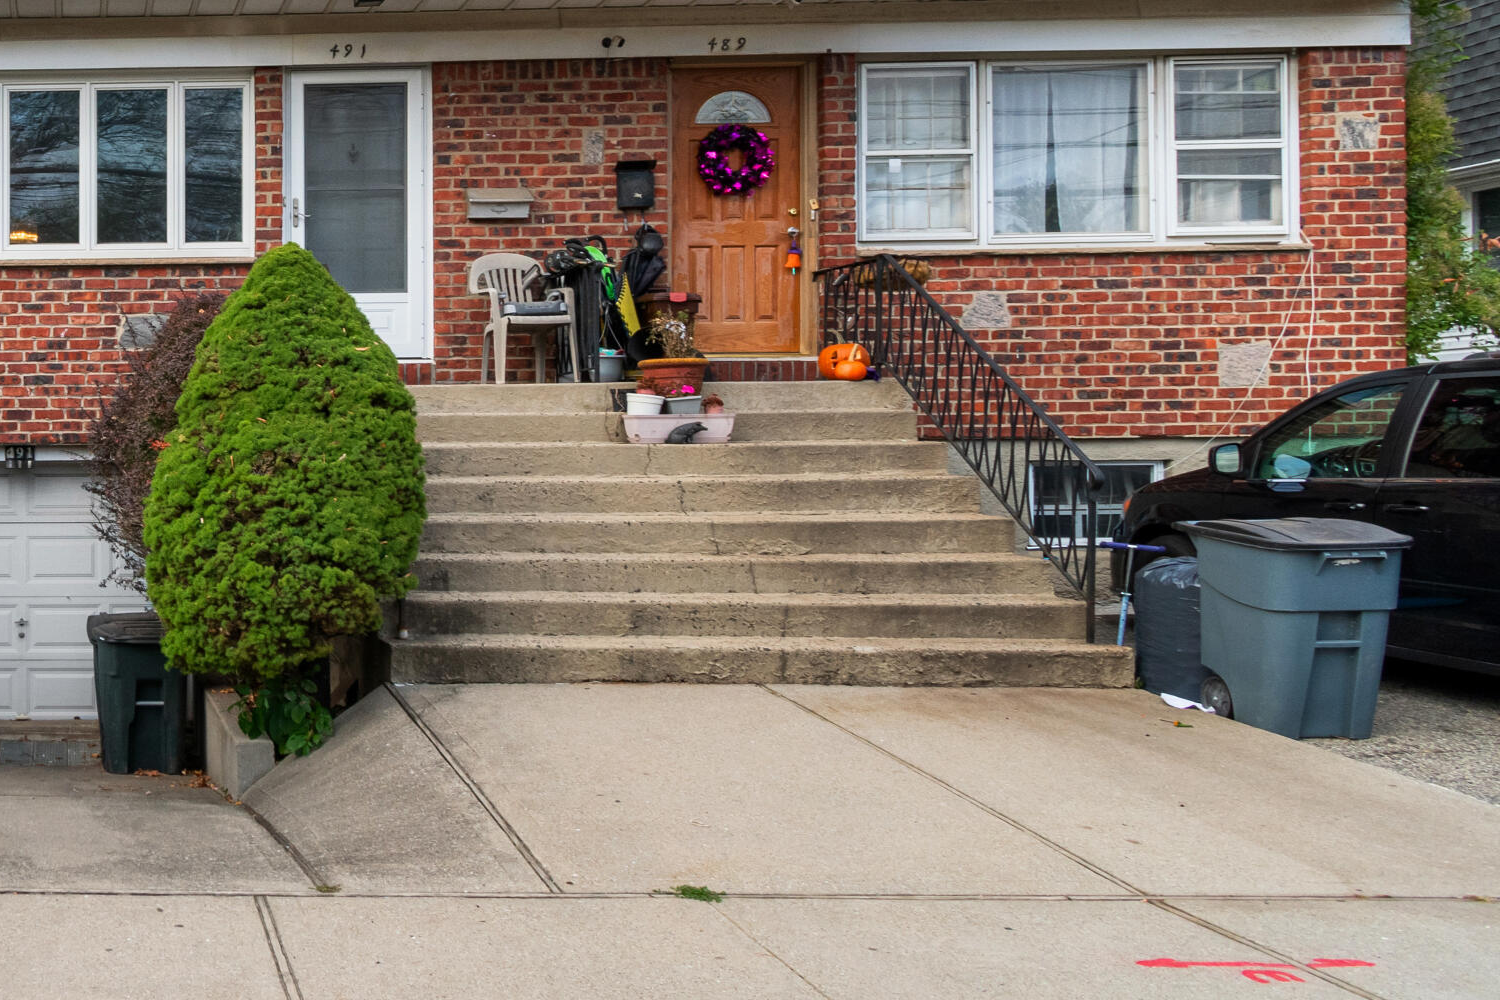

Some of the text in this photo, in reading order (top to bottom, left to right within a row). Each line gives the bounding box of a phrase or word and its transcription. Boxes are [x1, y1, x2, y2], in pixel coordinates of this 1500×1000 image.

[329, 43, 366, 59] 491
[708, 37, 747, 53] 489
[6, 446, 33, 459] 491
